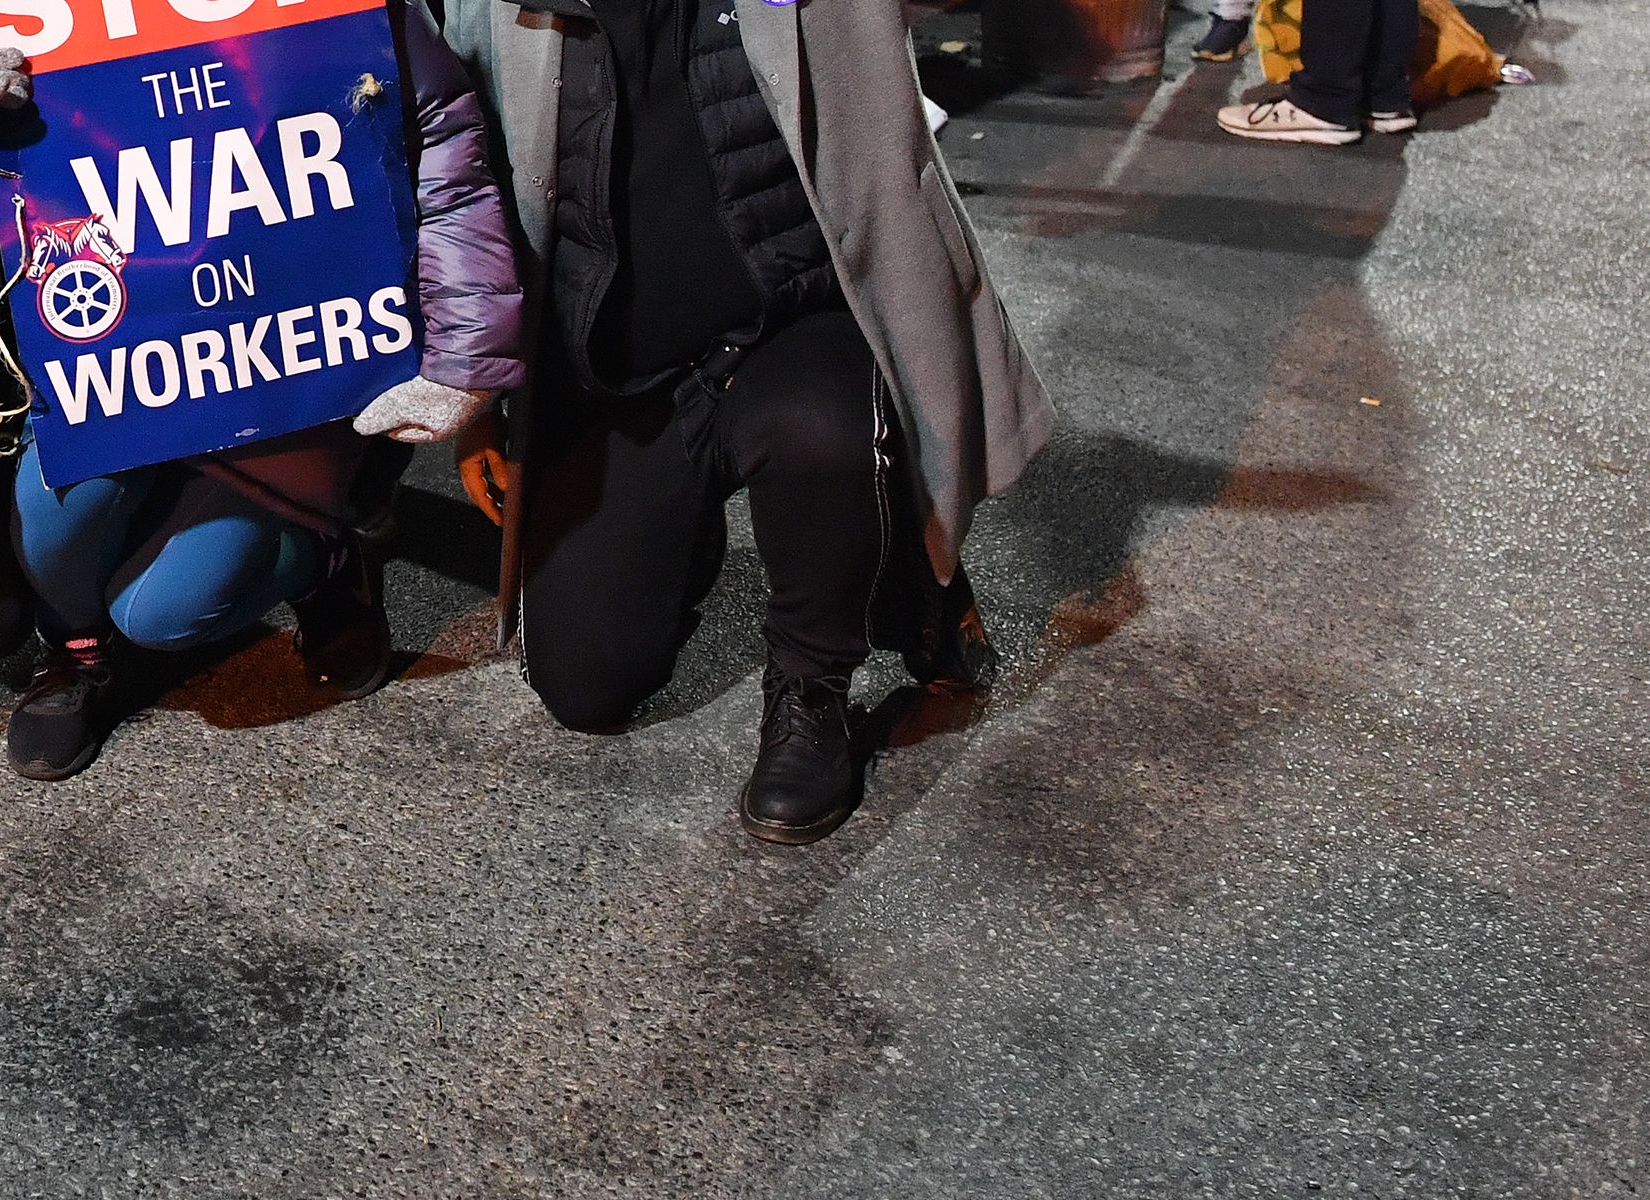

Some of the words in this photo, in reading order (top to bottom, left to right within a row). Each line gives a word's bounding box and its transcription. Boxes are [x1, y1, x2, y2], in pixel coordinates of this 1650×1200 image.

[140, 62, 232, 119] THE
[69, 112, 356, 256] WAR
[191, 254, 256, 308] ON
[44, 286, 414, 426] WORKERS
